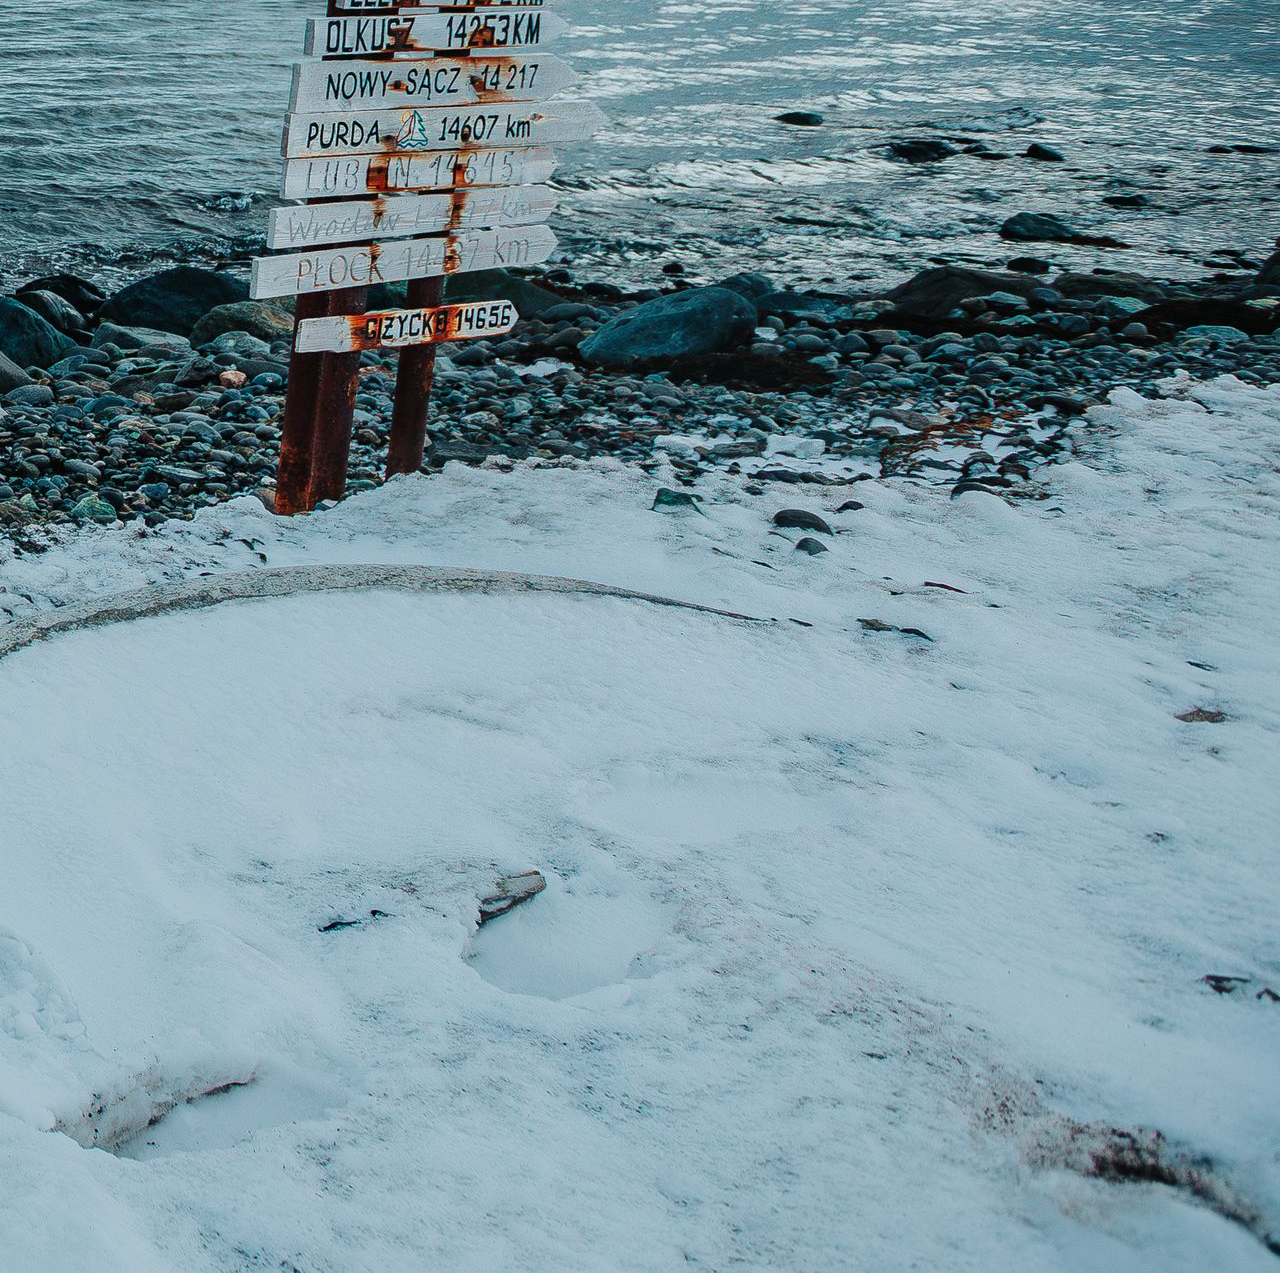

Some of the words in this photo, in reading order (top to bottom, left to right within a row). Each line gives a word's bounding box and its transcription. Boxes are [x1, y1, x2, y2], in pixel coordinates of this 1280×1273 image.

[327, 17, 416, 53] OLKUSZ
[326, 70, 392, 100] NOWY
[406, 67, 461, 100] SĄCZ
[306, 119, 380, 149] PURDA
[439, 114, 498, 142] 14607
[506, 114, 531, 139] km
[494, 234, 529, 265] km
[456, 304, 513, 332] 14656
